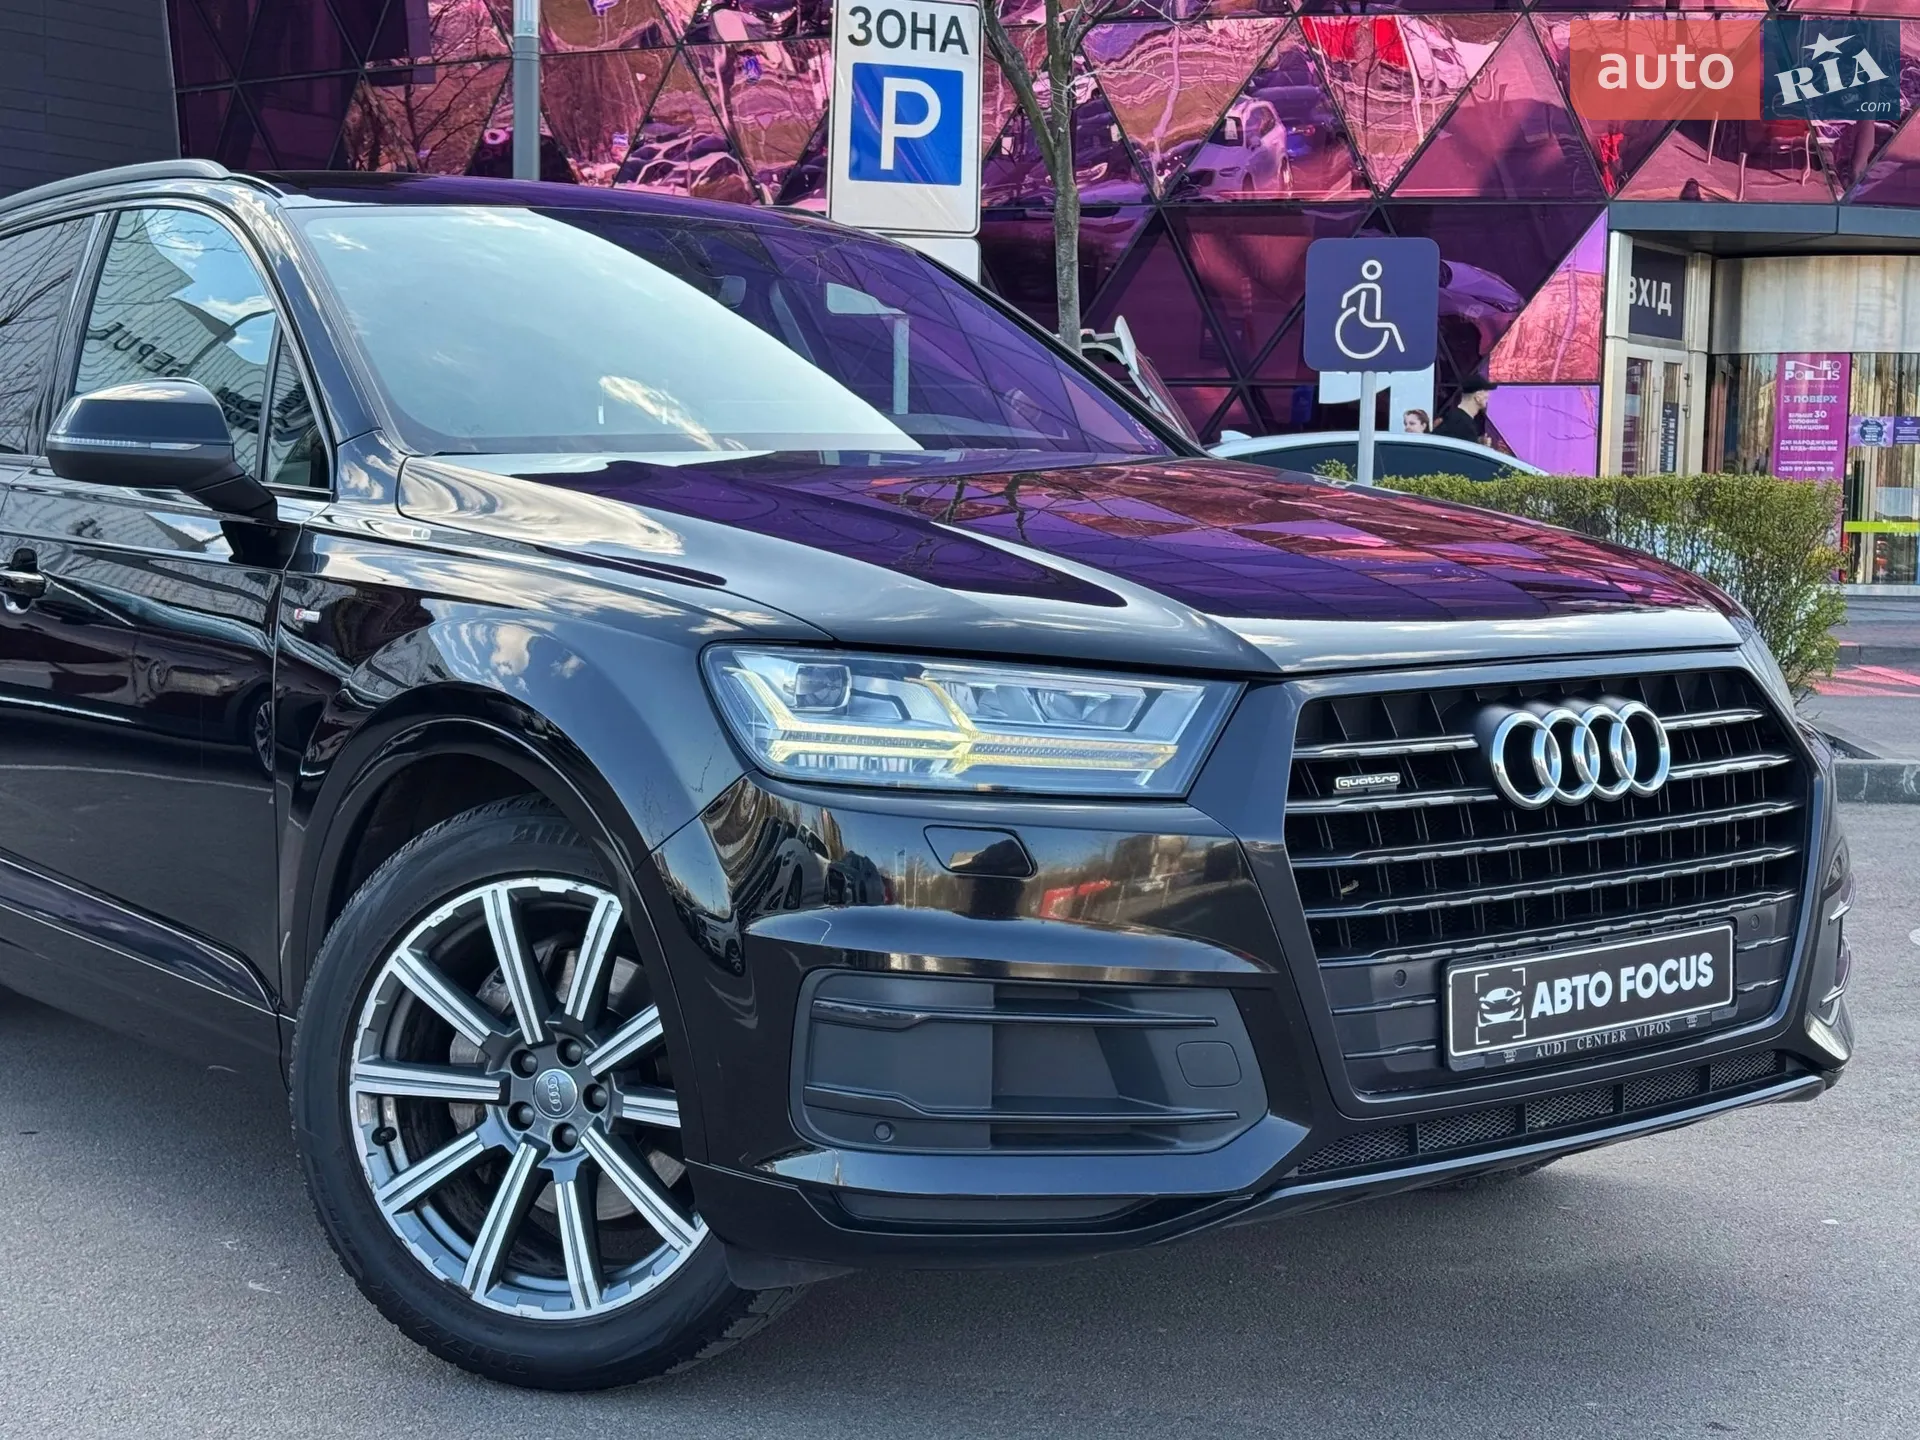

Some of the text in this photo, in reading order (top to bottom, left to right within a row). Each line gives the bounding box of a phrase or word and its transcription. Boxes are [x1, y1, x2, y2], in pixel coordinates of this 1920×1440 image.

[847, 6, 969, 55] ЗОНА
[880, 77, 942, 170] P
[1793, 395, 1838, 403] ПОВЕРХ
[1814, 410, 1827, 418] 30
[1340, 775, 1399, 788] quattro
[1619, 952, 1714, 1003] FOCUS
[1535, 1020, 1671, 1058] AUDI CENTER VIPOS
